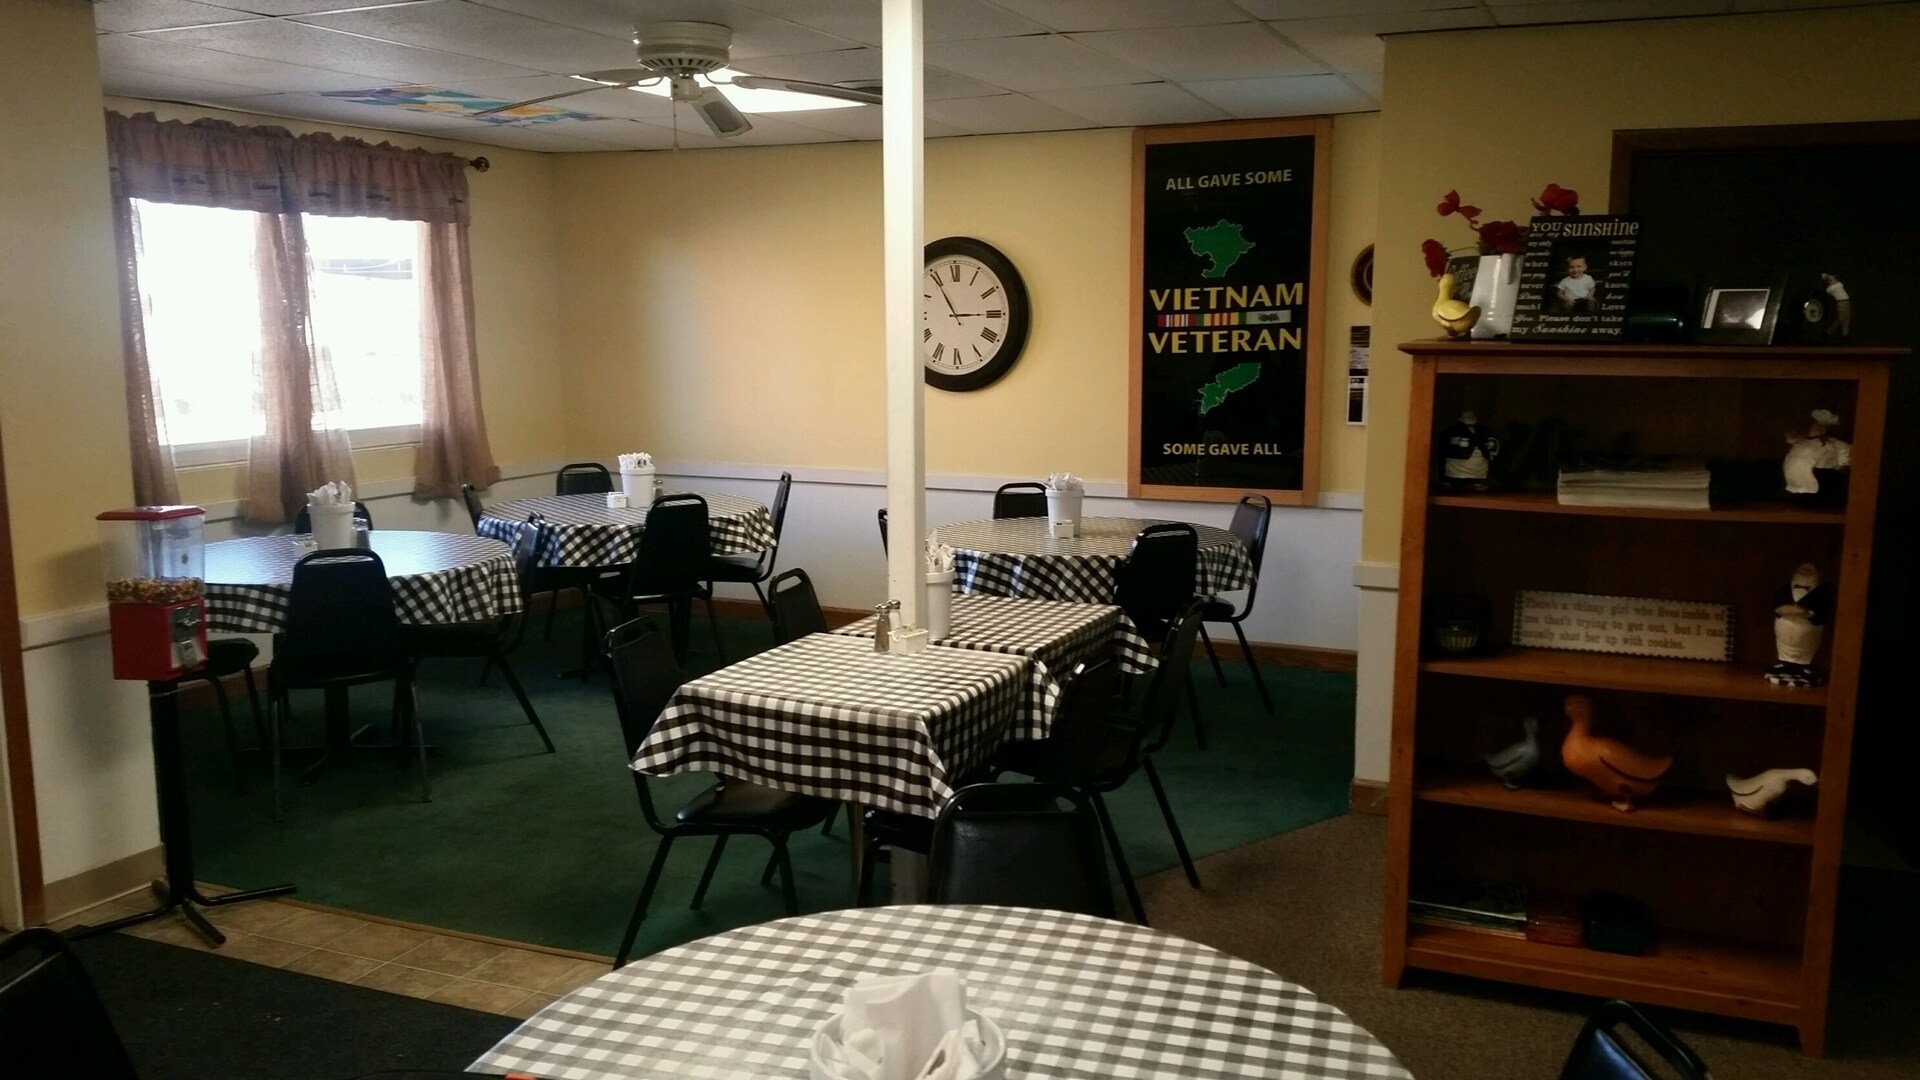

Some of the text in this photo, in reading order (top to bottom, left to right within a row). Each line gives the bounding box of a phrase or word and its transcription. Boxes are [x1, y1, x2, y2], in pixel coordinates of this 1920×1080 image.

[1165, 169, 1292, 191] ALL GAVE SOME
[1531, 222, 1563, 232] YOU
[1149, 282, 1304, 311] VIETNAM
[1512, 326, 1528, 335] my
[1532, 324, 1587, 334] Sunshine
[1148, 327, 1302, 354] VETERAN
[1163, 442, 1282, 456] SOME GAVE ALL
[1612, 619, 1624, 630] to
[1674, 622, 1692, 636] but
